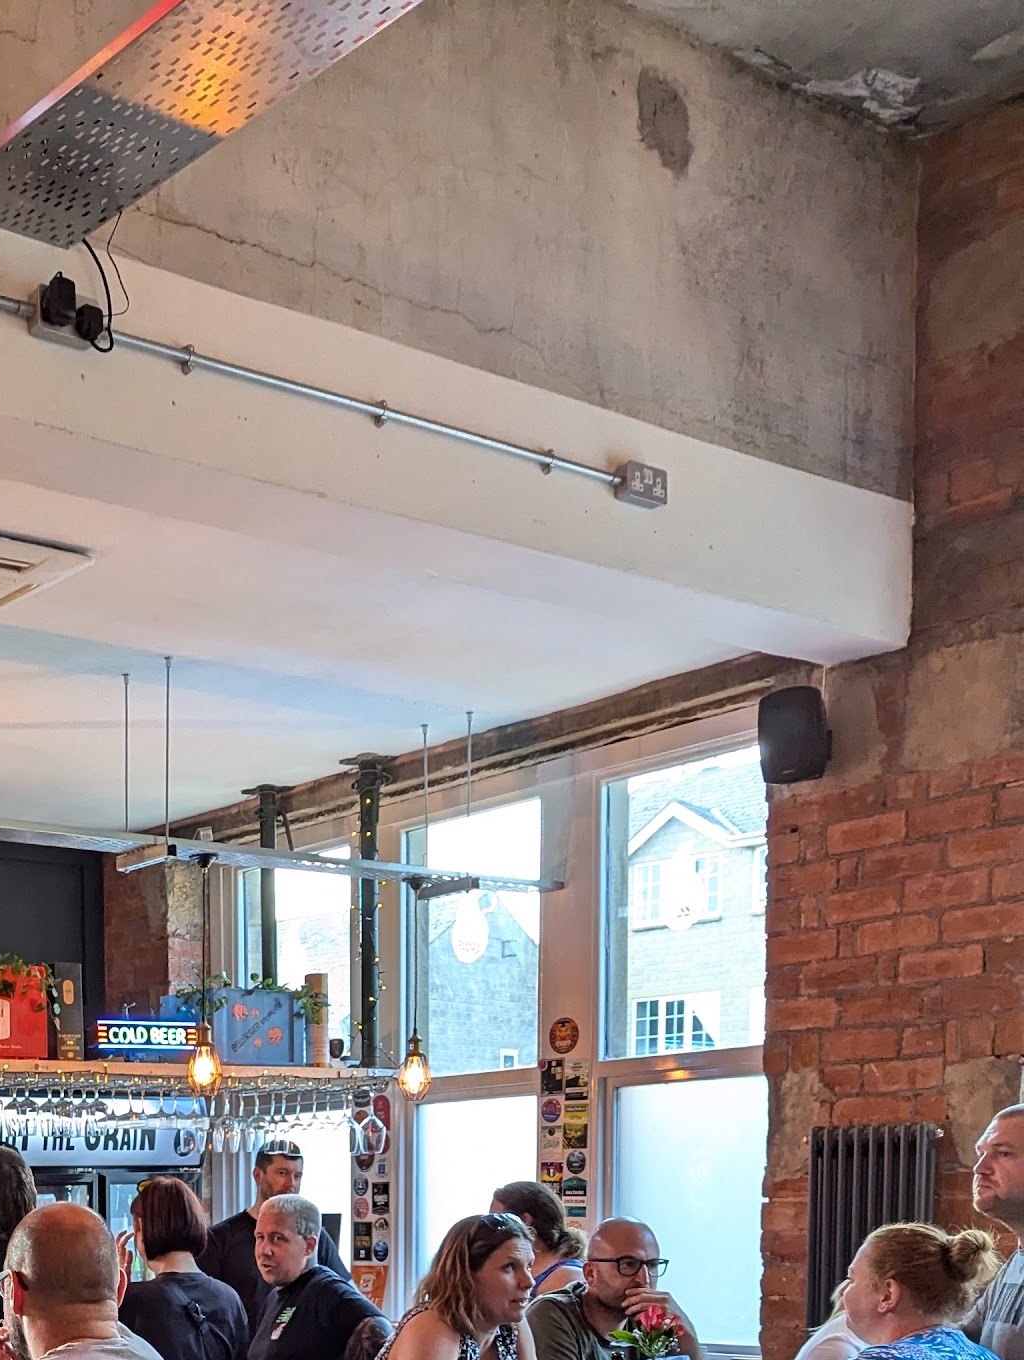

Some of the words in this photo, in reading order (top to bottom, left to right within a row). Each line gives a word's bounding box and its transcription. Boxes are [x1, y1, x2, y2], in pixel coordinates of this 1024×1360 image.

[108, 1026, 148, 1044] COLD
[149, 1027, 187, 1045] BEER
[84, 1117, 157, 1151] GRAIN
